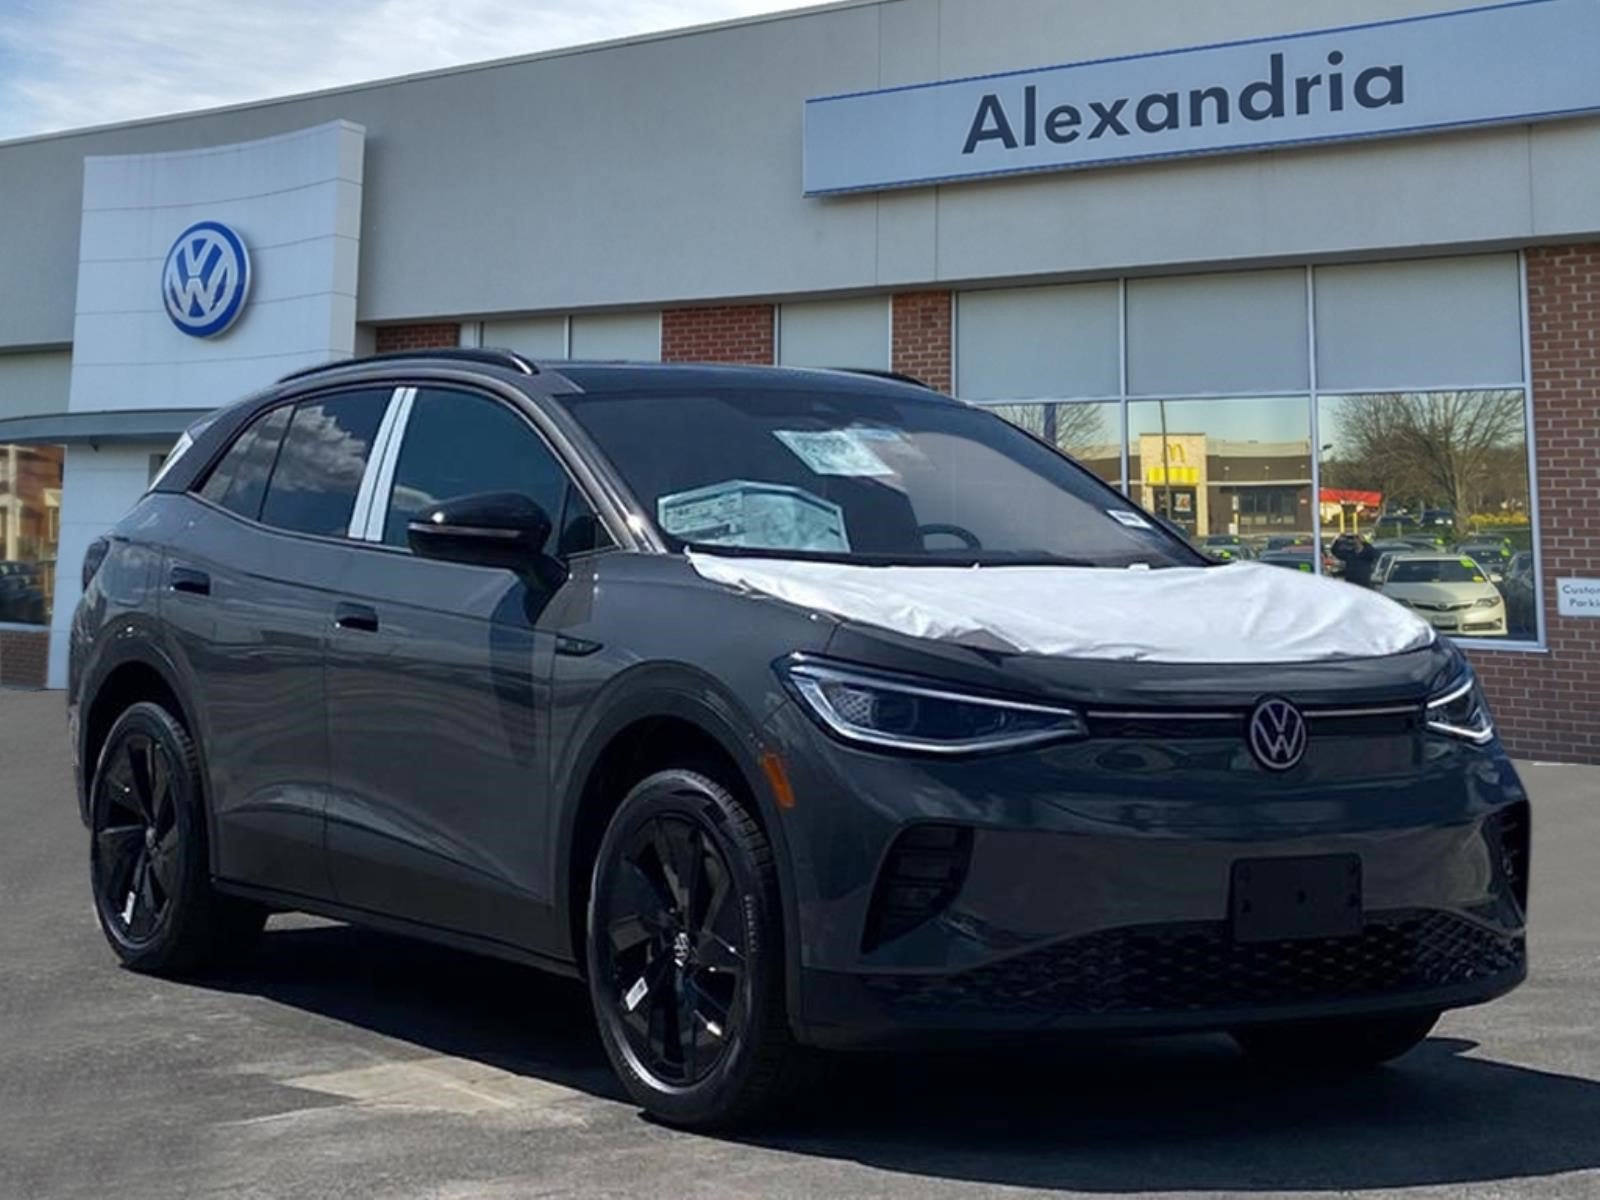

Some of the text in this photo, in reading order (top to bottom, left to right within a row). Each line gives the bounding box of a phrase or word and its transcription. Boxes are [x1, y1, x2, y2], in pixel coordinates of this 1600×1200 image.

[962, 50, 1404, 154] Alexandria
[165, 229, 239, 328] VW
[1252, 701, 1304, 766] VW
